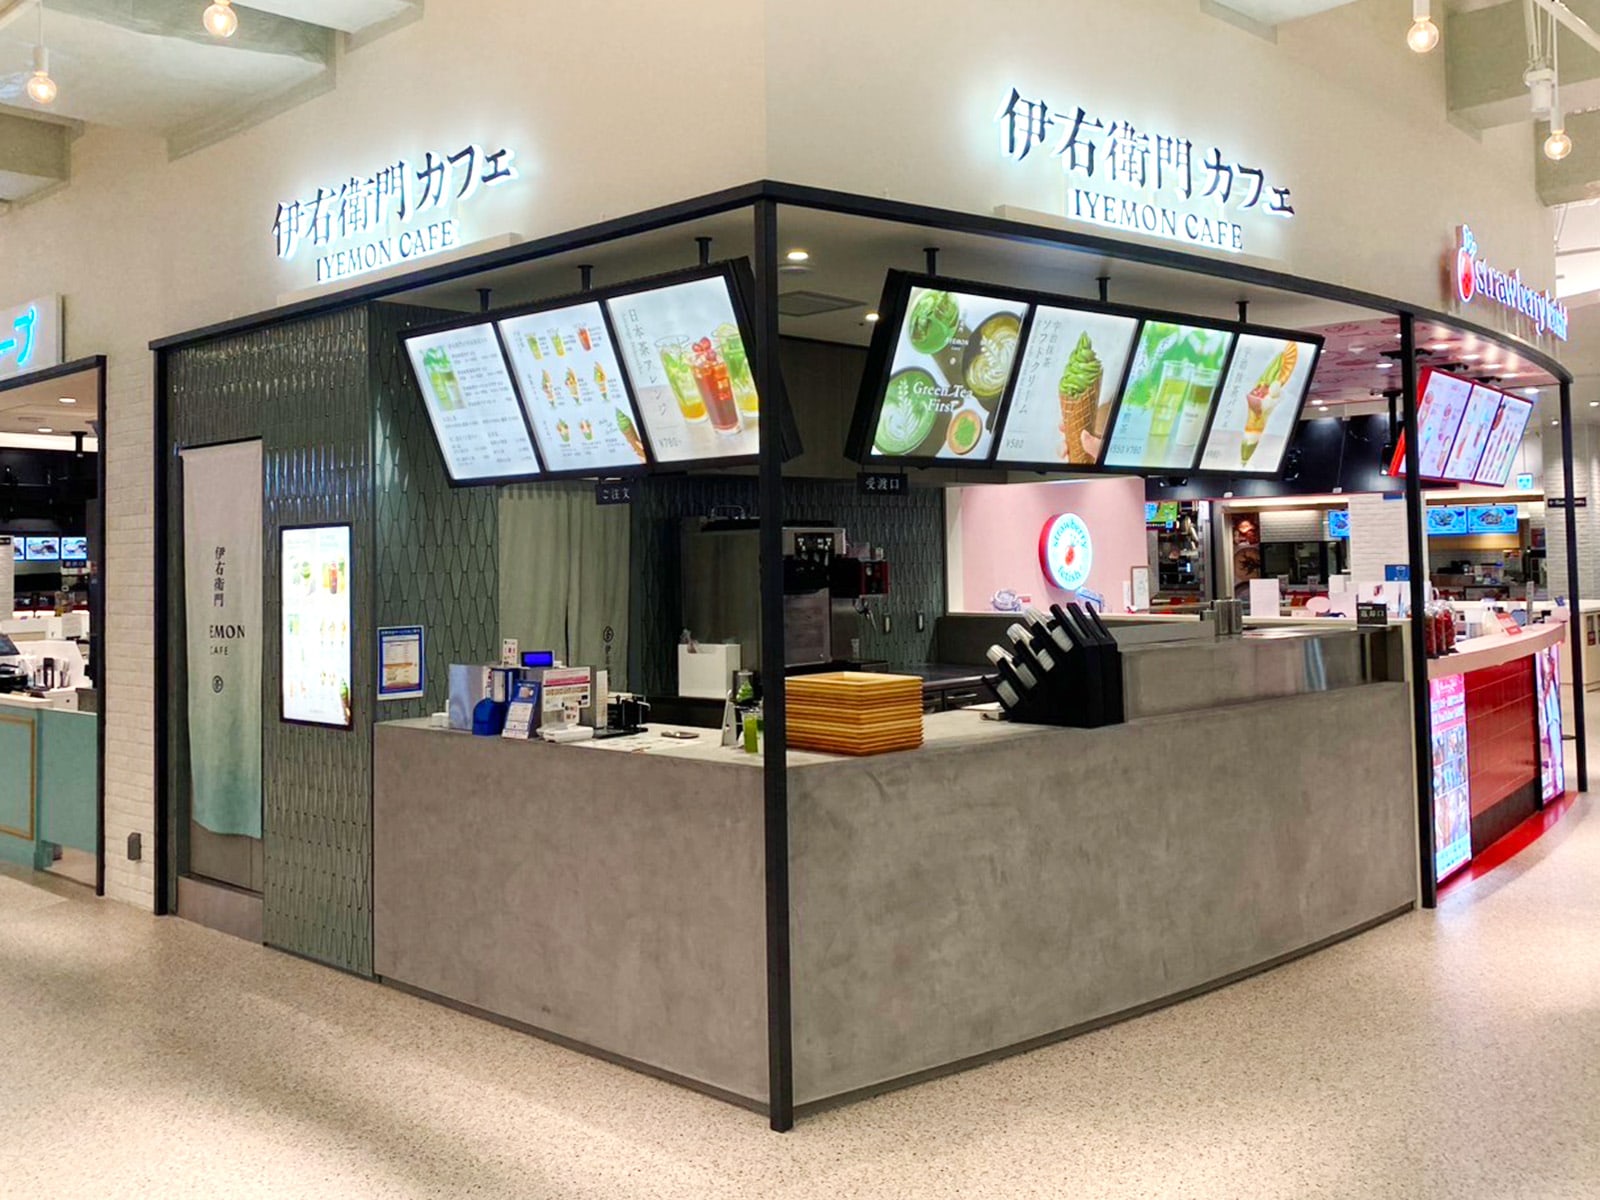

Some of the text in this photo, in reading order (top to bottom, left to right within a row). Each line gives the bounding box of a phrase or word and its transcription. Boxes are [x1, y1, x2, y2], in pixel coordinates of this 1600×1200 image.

[1074, 189, 1244, 250] IYEMON CAFE
[315, 219, 454, 282] IYEMON CAFE
[912, 380, 975, 399] Green Tea
[1018, 318, 1053, 415] ソフトクリーム
[928, 398, 960, 413] First
[213, 546, 226, 608] 伊右衛門
